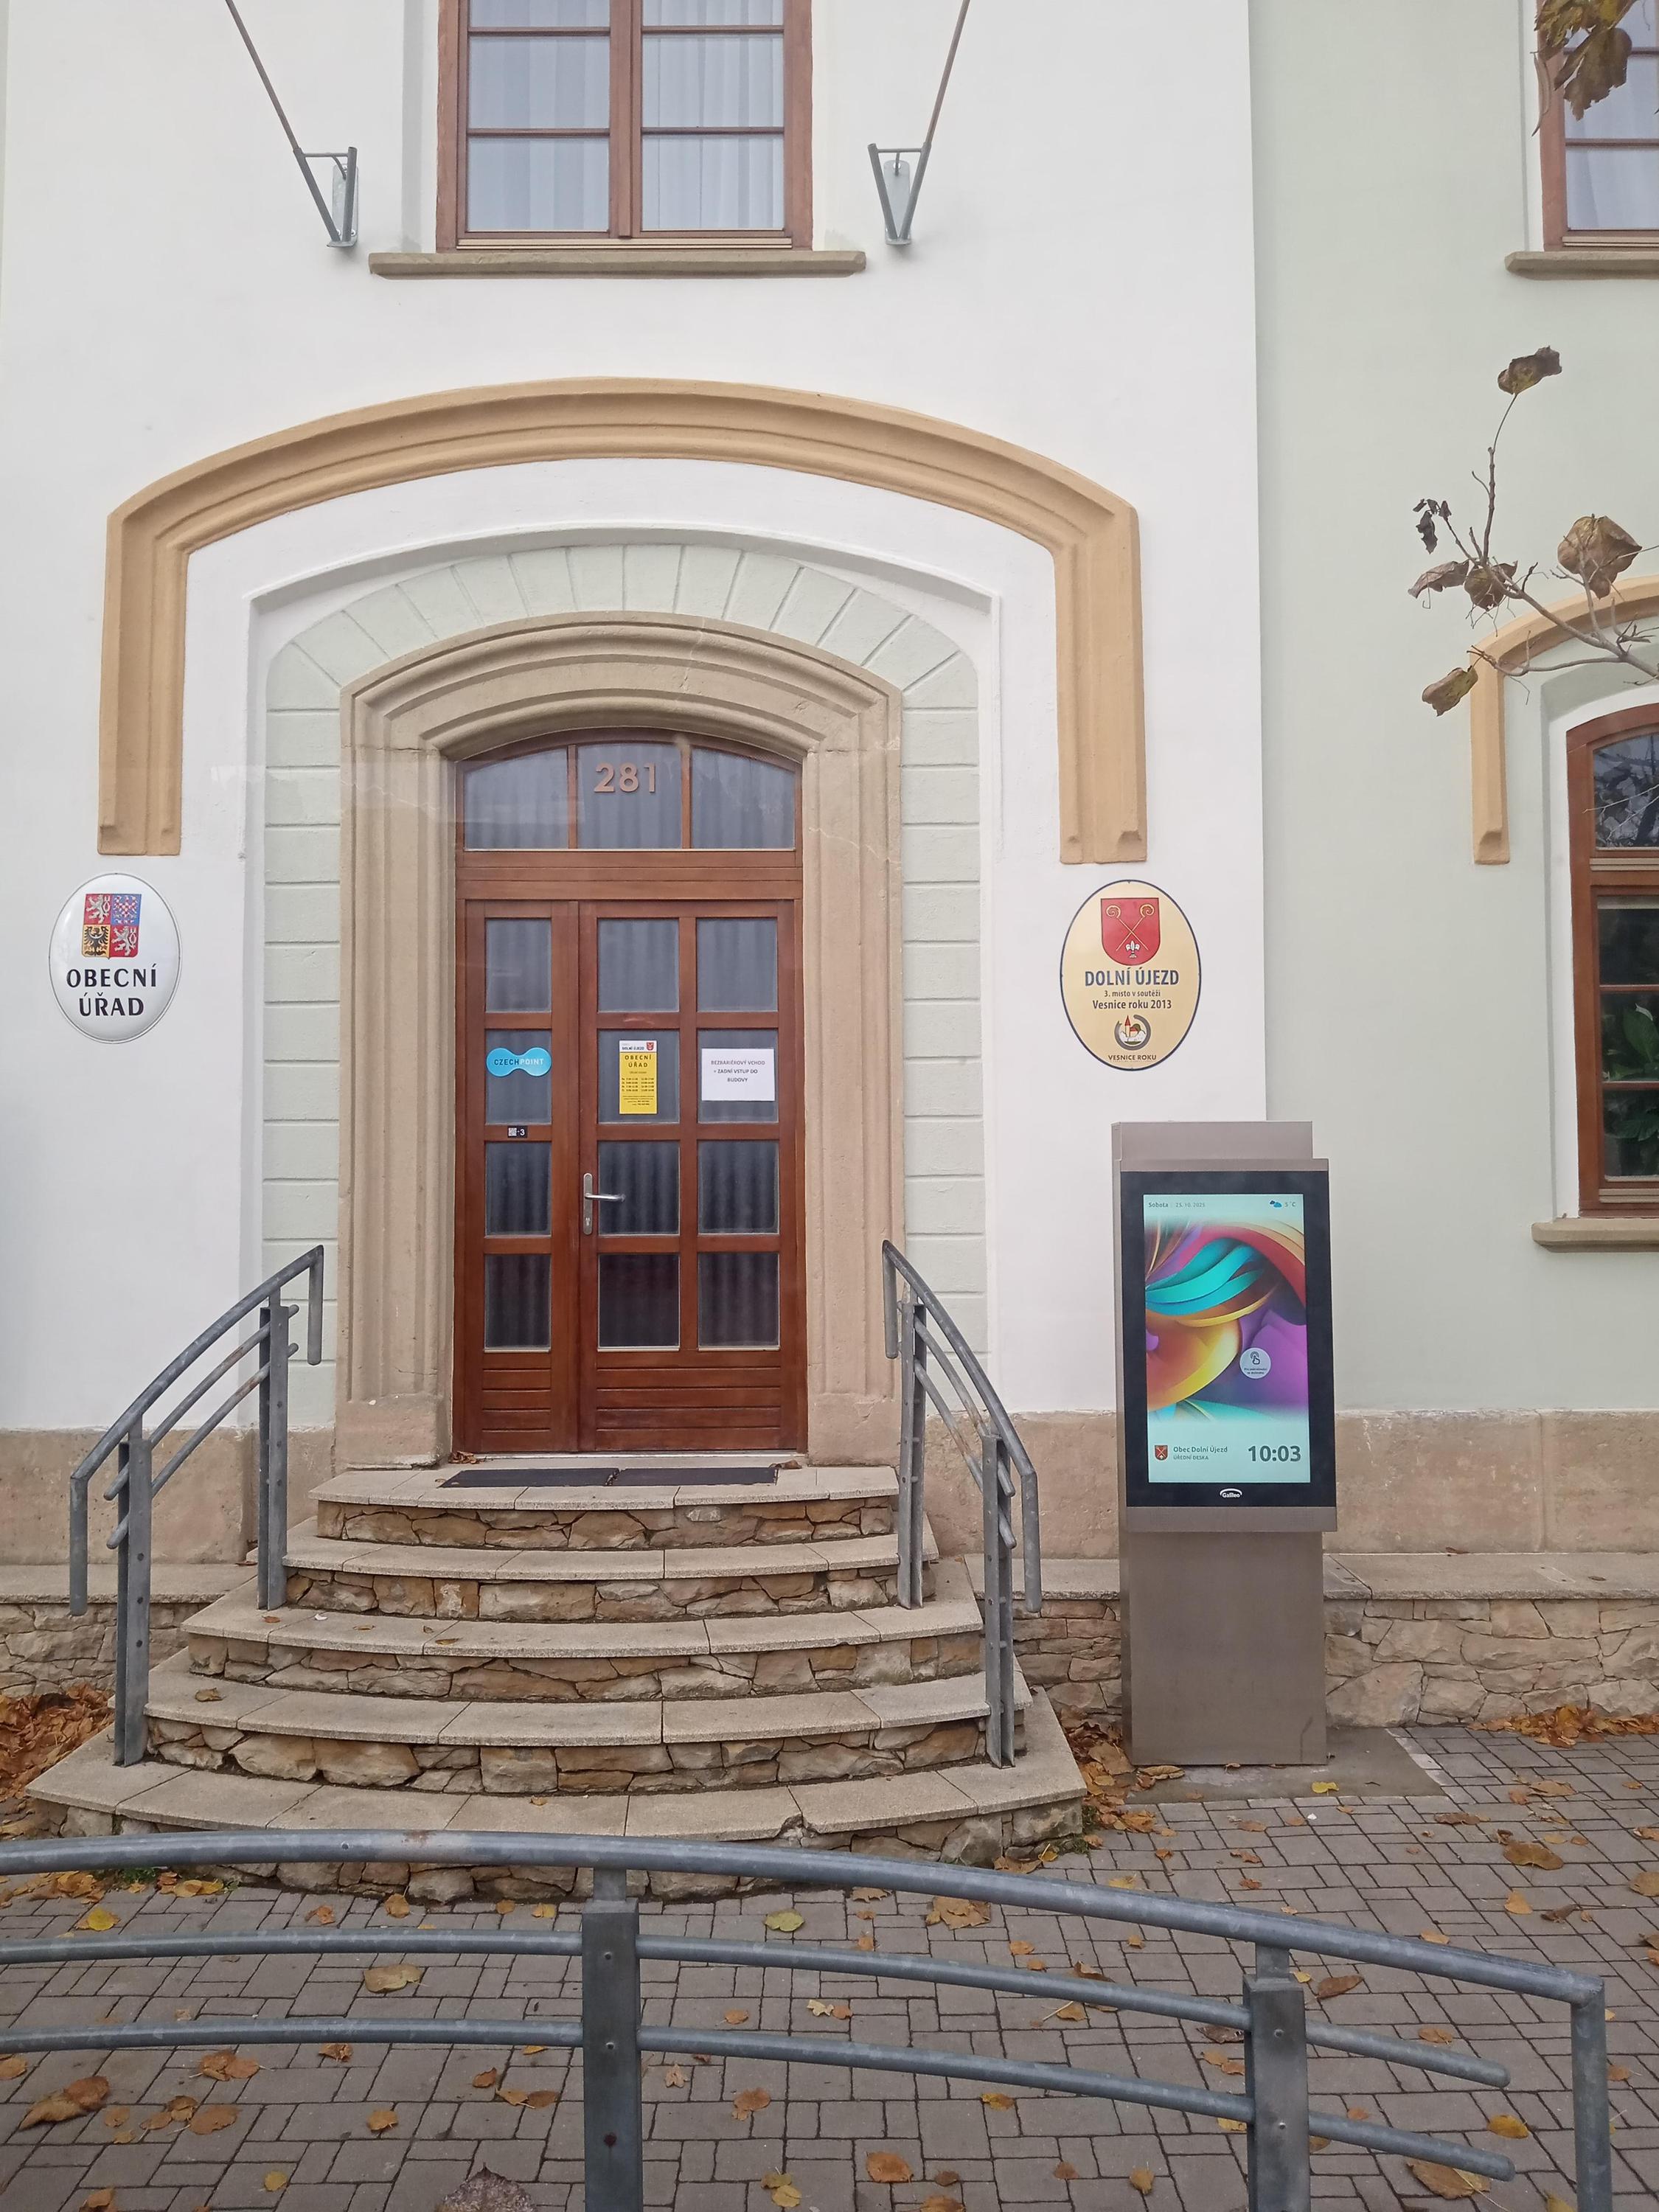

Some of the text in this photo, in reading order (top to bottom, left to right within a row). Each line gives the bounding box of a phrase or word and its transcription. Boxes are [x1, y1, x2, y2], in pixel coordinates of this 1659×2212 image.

[594, 762, 655, 793] 281
[66, 963, 158, 987] OBECNÍ
[1085, 967, 1179, 987] DOLNÍ ÚJEZD
[79, 992, 145, 1017] ÚŘAD
[1092, 999, 1172, 1009] Vesnice roku 2013
[1210, 1445, 1228, 1453] Újezd
[1248, 1445, 1301, 1462] 10:03
